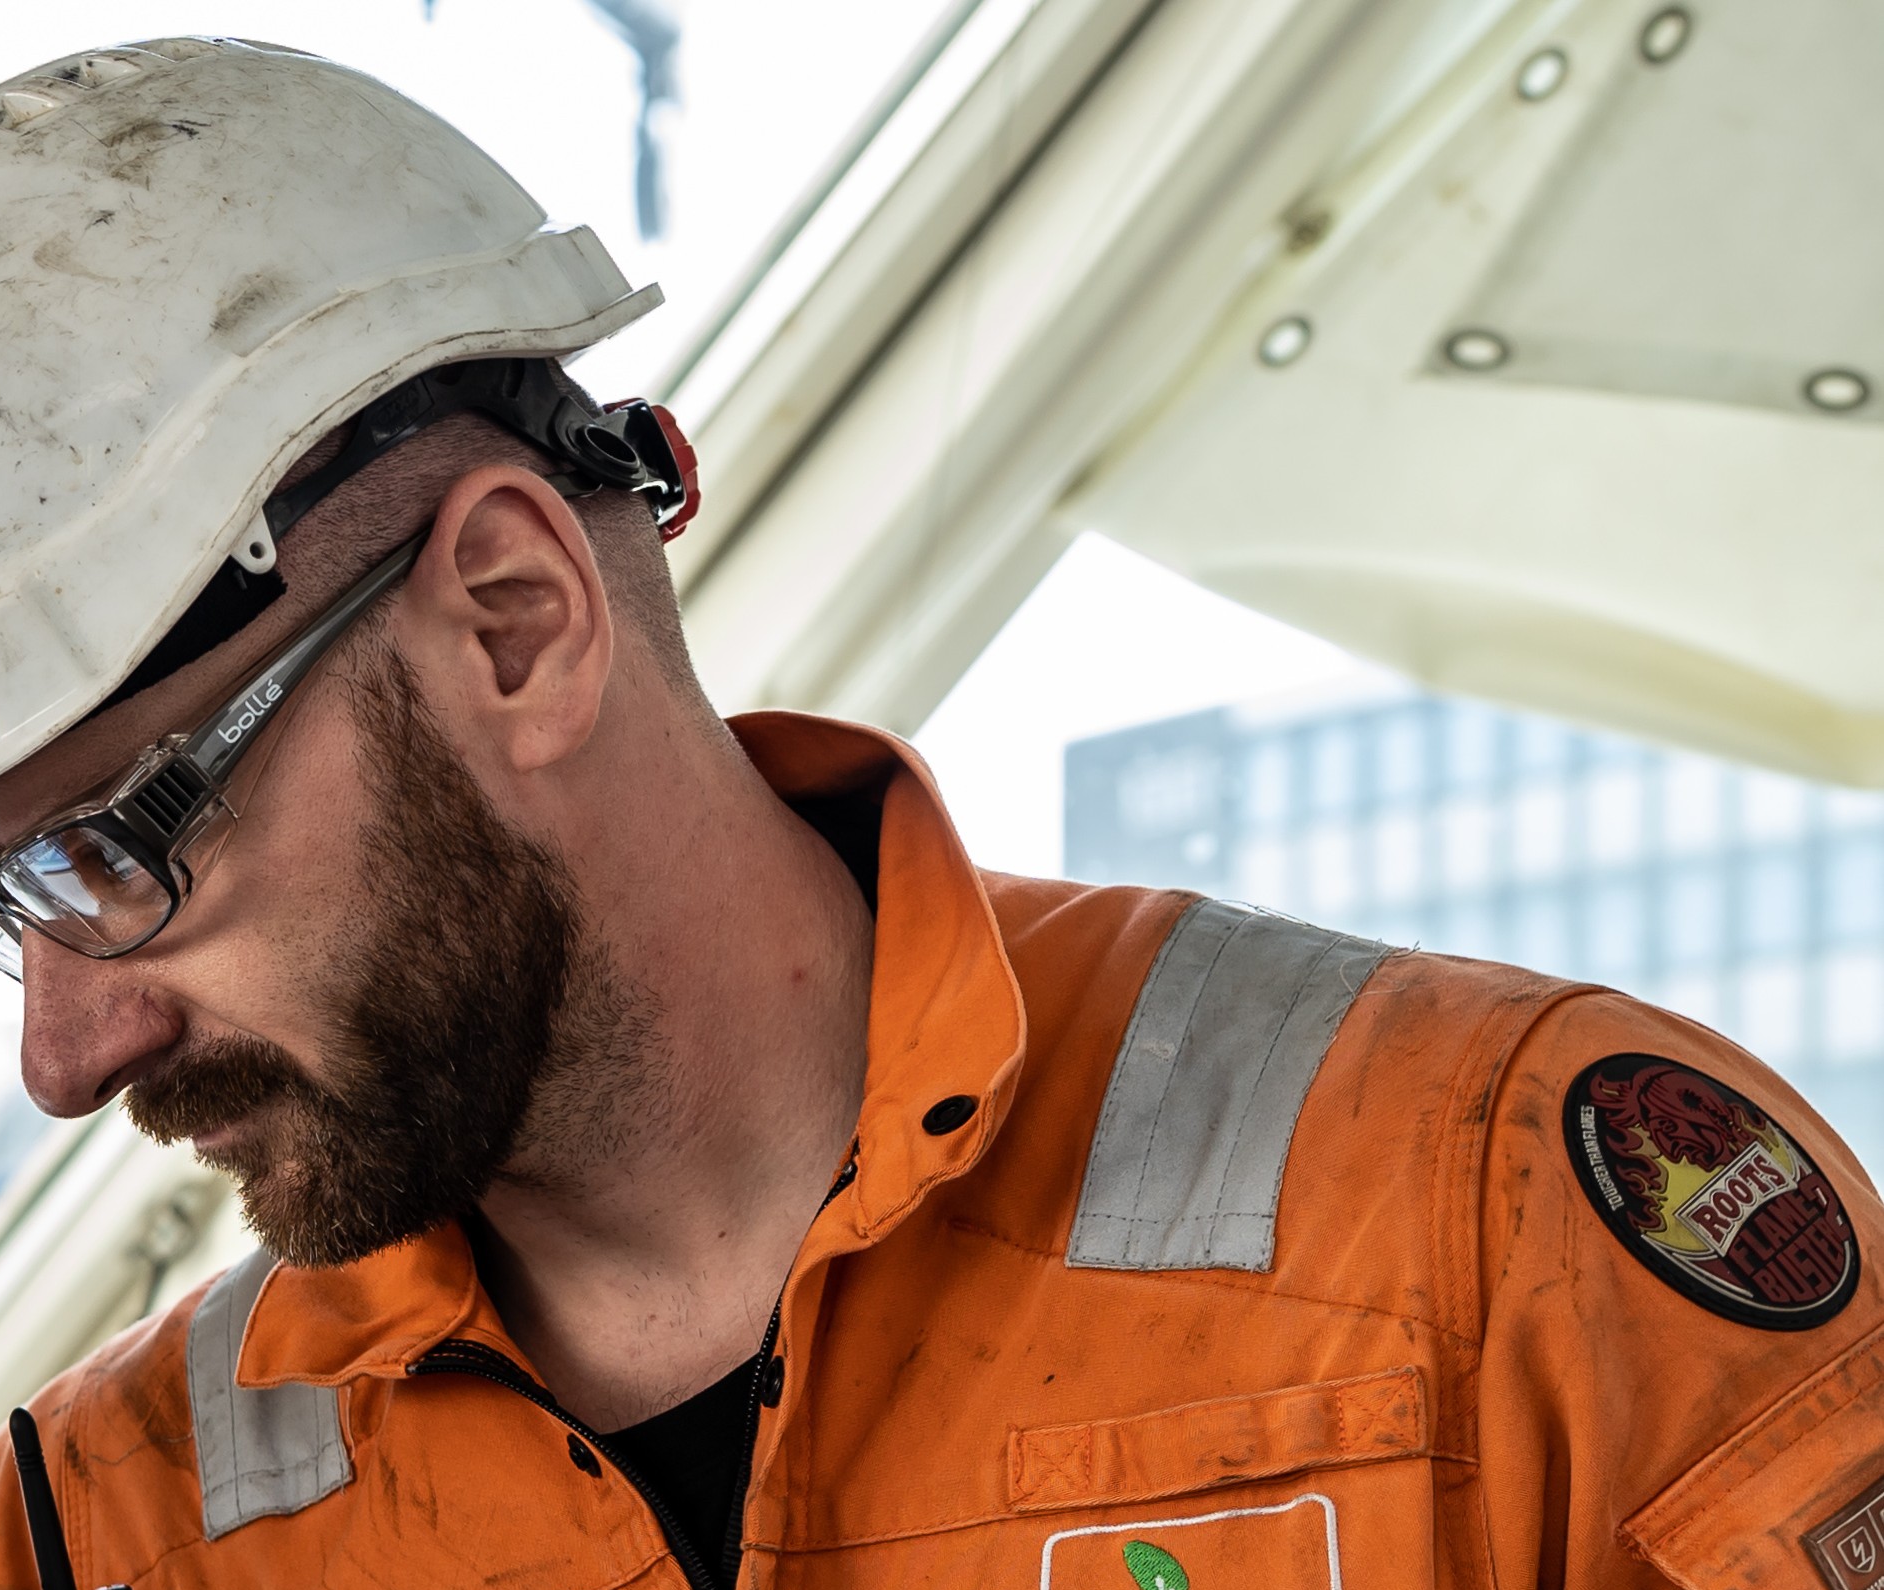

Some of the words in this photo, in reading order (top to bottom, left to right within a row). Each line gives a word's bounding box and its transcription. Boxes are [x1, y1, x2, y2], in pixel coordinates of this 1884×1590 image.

[217, 678, 283, 744] bollé
[1584, 1139, 1605, 1166] THAN
[1689, 1154, 1787, 1245] ROOTS
